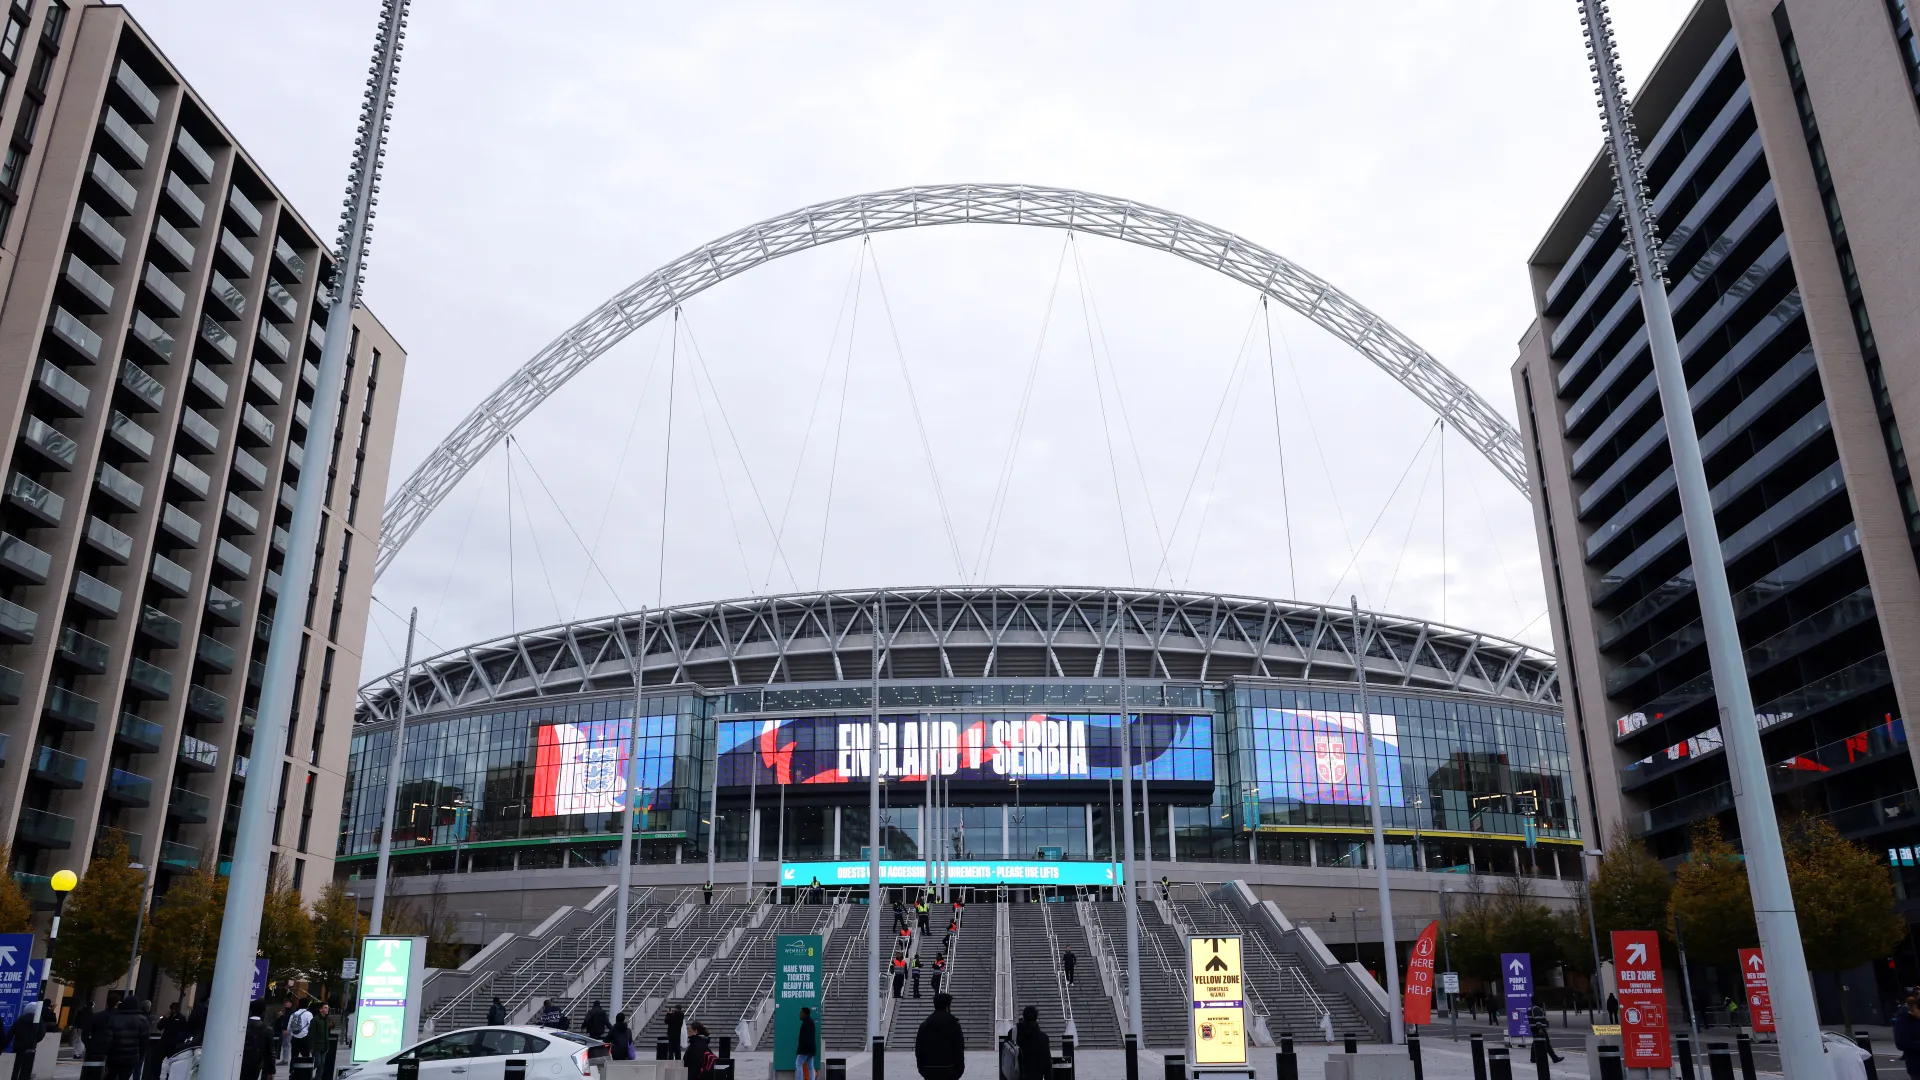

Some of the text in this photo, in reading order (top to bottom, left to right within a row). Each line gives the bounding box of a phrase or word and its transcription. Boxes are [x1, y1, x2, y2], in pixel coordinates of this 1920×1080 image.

[838, 721, 958, 777] ENGLAND
[992, 720, 1088, 775] SERBIA
[934, 866, 990, 878] EUIREMENTS
[996, 866, 1024, 878] PLEASE
[1025, 866, 1040, 878] USE
[1040, 867, 1058, 878] LIFTS
[1411, 958, 1434, 968] HERE
[4, 972, 22, 982] ZONE
[1194, 974, 1240, 984] YELLOW ZONE
[1414, 972, 1427, 982] TO
[1621, 970, 1656, 980] RED ZONE
[782, 990, 816, 998] INSPECTION
[1408, 984, 1432, 996] HELP
